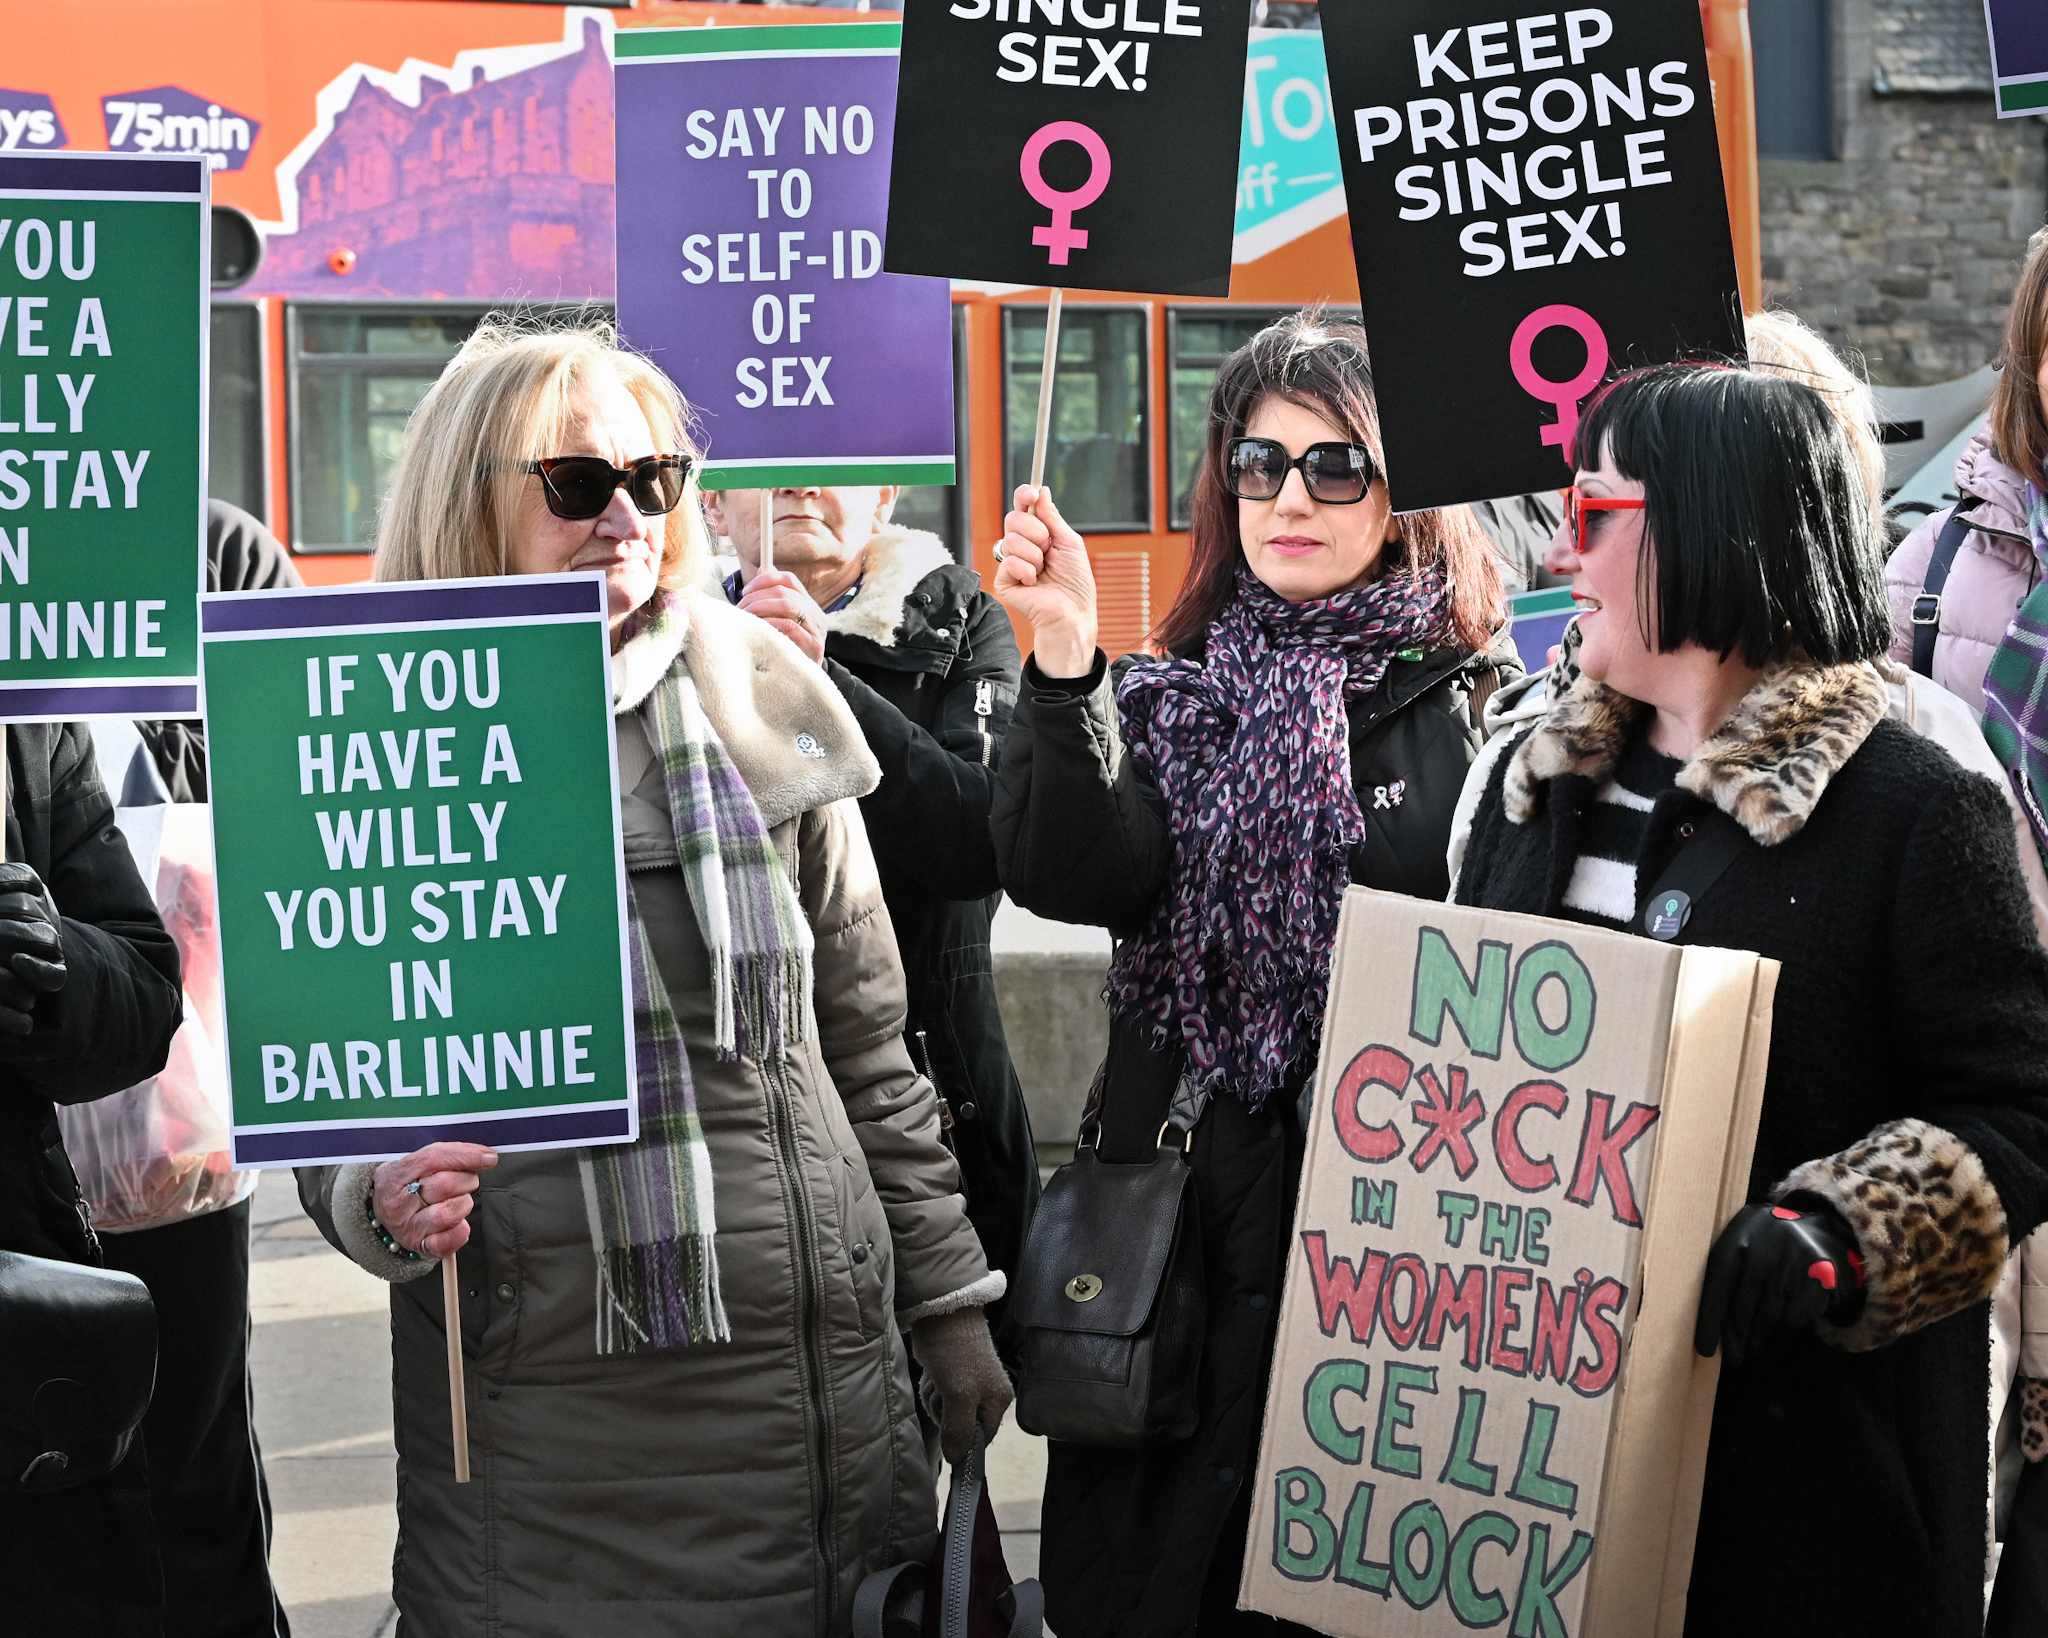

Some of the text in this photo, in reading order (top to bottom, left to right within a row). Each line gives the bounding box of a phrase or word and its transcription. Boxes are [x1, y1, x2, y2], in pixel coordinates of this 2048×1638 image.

[996, 31, 1149, 91] SEX!
[1413, 8, 1613, 88] KEEP
[105, 101, 250, 150] 75min
[685, 104, 875, 159] SAY NO
[1245, 55, 1336, 147] To
[1354, 61, 1695, 162] PRISONS
[748, 168, 813, 219] TO
[1235, 161, 1279, 212] ff
[1395, 129, 1672, 221] SINGLE
[681, 230, 883, 284] SELF-ID
[1459, 201, 1626, 277] SEX!
[70, 297, 113, 357] A
[752, 293, 815, 345] OF
[734, 355, 835, 409] SEX
[0, 449, 151, 510] STAY
[306, 647, 500, 718] IF YOU
[297, 724, 523, 796] HAVE A
[314, 800, 508, 871] WILLY
[264, 874, 568, 951] YOU STAY
[389, 958, 454, 1022] IN
[1409, 926, 1597, 1072] NO
[260, 1024, 596, 1105] BARLINNIE
[1351, 1176, 1551, 1266] IN THE
[1301, 1230, 1628, 1398] WOMEN'S
[1303, 1358, 1578, 1519] CELL
[1271, 1465, 1593, 1638] BLOCK
